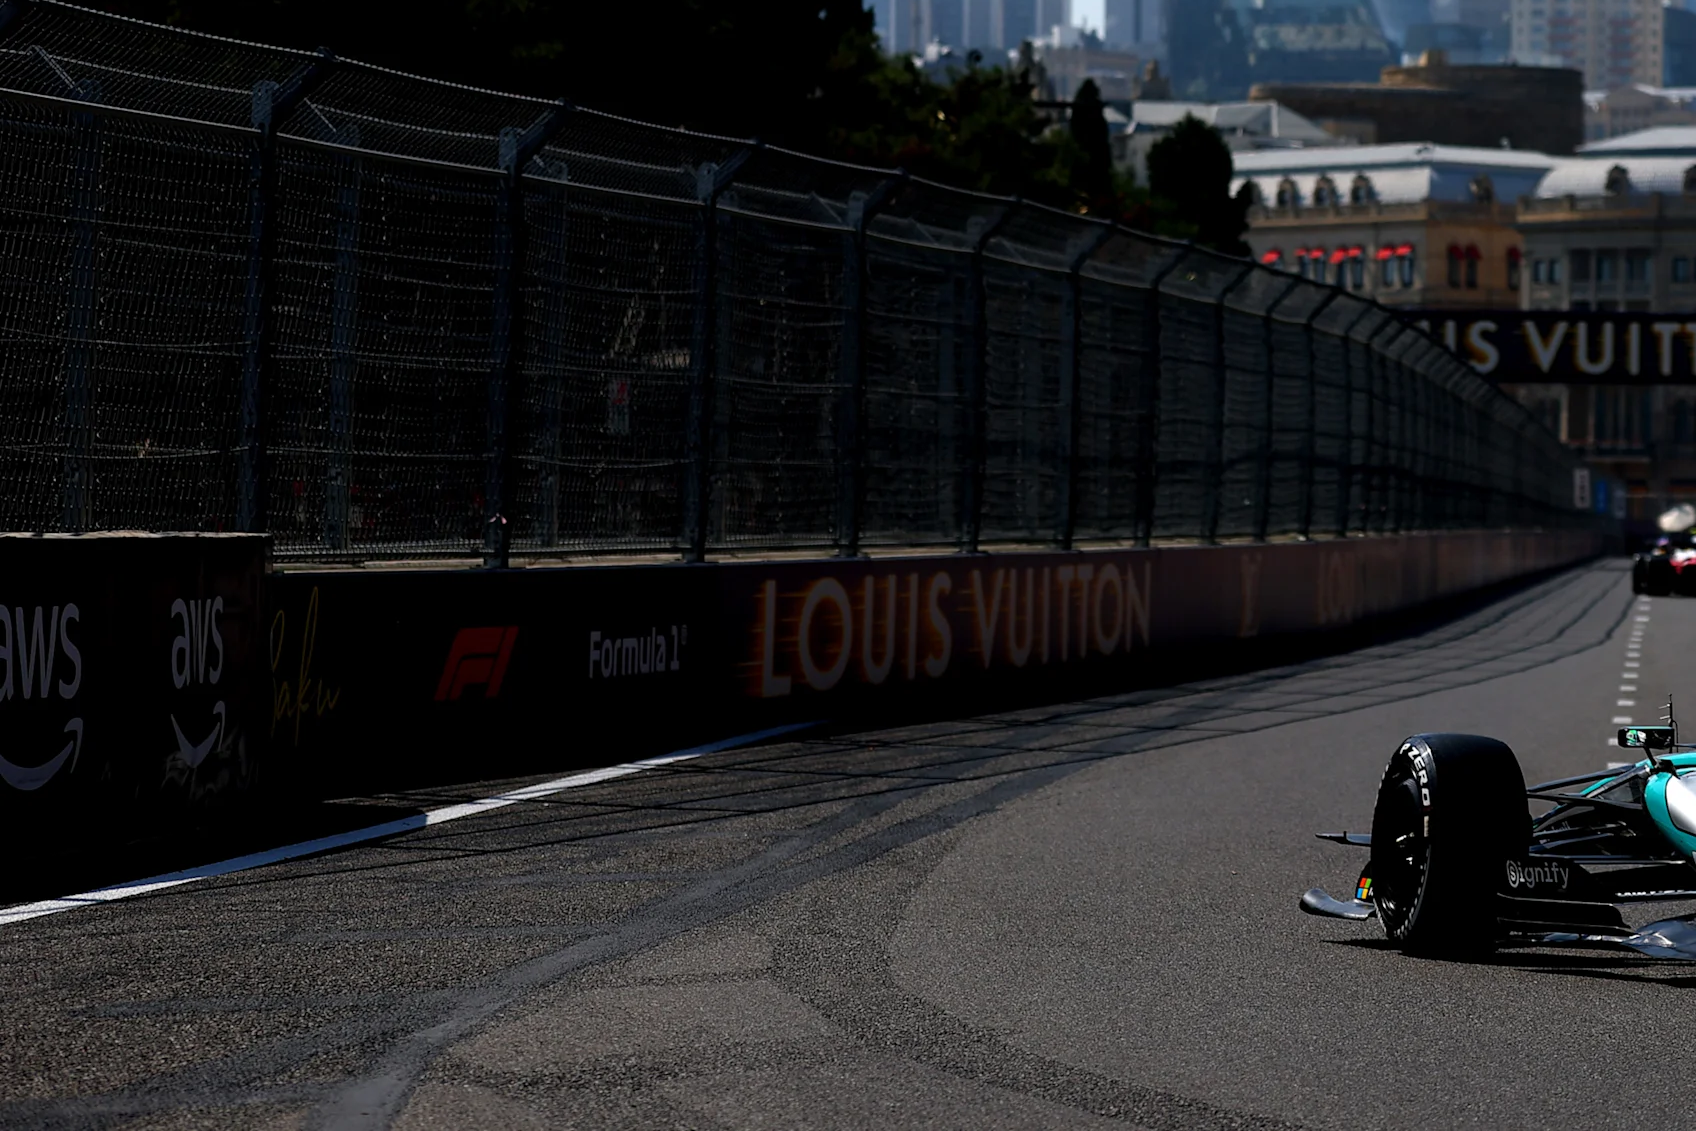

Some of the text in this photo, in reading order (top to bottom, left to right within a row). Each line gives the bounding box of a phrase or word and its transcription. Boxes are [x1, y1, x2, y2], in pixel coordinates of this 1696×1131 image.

[170, 595, 224, 690] aws
[588, 626, 667, 679] Formula
[762, 572, 952, 698] LOUIS
[970, 561, 1152, 669] VUITTON
[1408, 746, 1431, 807] ZERO
